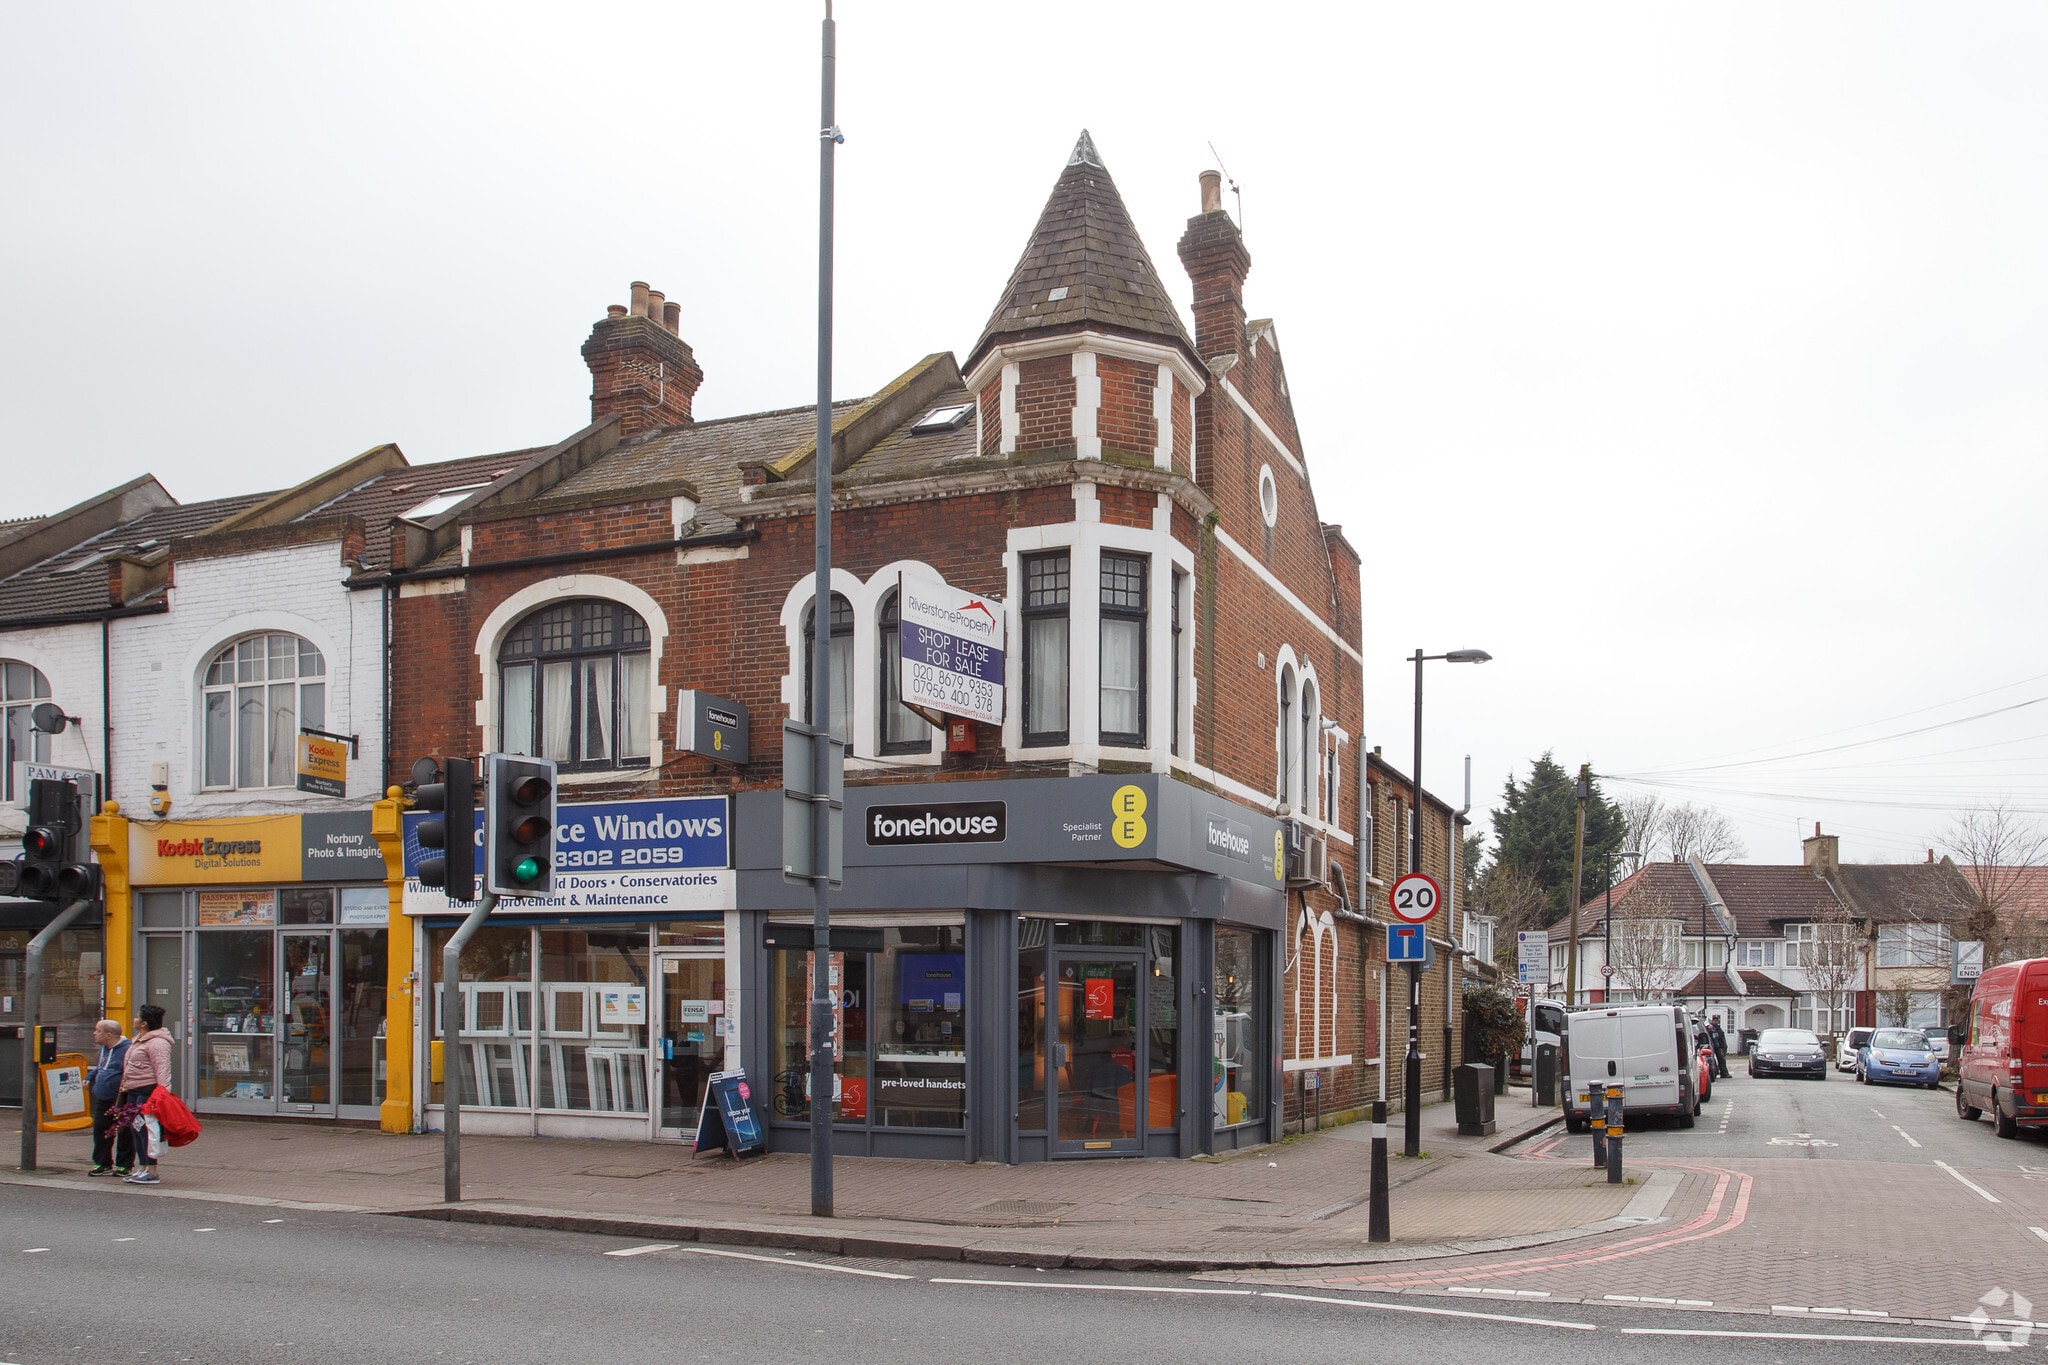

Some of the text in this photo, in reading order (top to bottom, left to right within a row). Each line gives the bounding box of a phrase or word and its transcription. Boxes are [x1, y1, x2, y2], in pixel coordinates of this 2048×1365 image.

[918, 628, 989, 662] SHOP LEASE
[926, 648, 981, 677] FOR SALE
[913, 663, 993, 698] 020 8679 9353
[913, 679, 992, 712] 07956 400 378
[913, 695, 993, 720] www.riverstoneproperty.co.uk
[709, 711, 736, 726] fonehouse
[308, 743, 335, 757] Kodak
[308, 753, 340, 767] Express
[28, 766, 57, 779] PAM
[592, 813, 723, 842] Windows
[873, 813, 998, 838] fonehouse
[1063, 822, 1102, 832] Specialist
[326, 833, 364, 846] Norbury
[1071, 833, 1102, 841] Partner
[1208, 821, 1249, 855] fonehouse
[308, 846, 383, 859] Photo & Imaging
[620, 847, 684, 865] 2059
[195, 857, 261, 870] Digital Solutions
[570, 877, 607, 889] Doors
[620, 873, 718, 888] Conservatories
[201, 892, 275, 901] PASSPORT PICTURES
[570, 894, 581, 906] &
[585, 893, 668, 906] Maintenance
[1398, 888, 1433, 908] 20
[881, 1078, 966, 1089] pre-loved handsets
